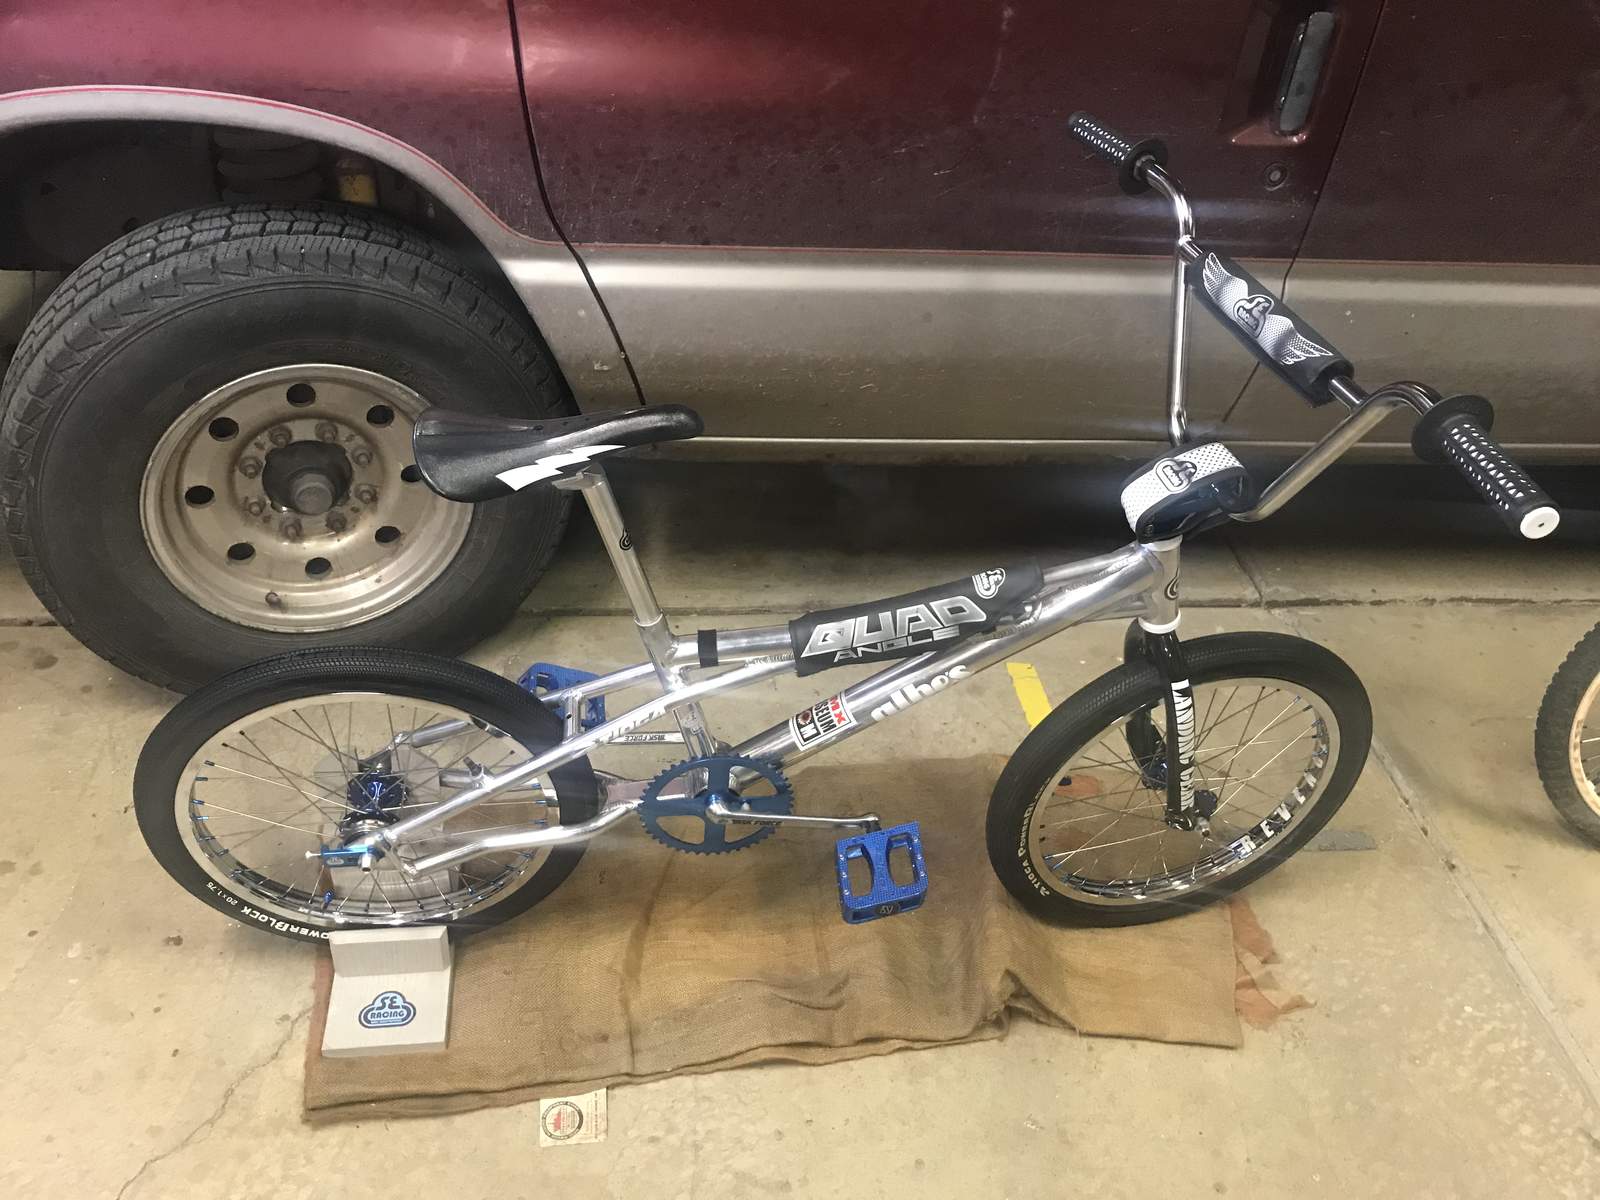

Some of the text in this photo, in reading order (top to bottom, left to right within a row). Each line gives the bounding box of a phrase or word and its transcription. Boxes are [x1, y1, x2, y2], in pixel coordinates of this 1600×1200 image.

[801, 596, 987, 658] QUAD
[834, 626, 960, 663] ANGLE
[813, 700, 837, 733] SEUM
[1171, 679, 1196, 765] LANDING
[240, 905, 330, 940] OWERBLOCK
[370, 1010, 405, 1019] RACING
[375, 995, 401, 1011] SE
